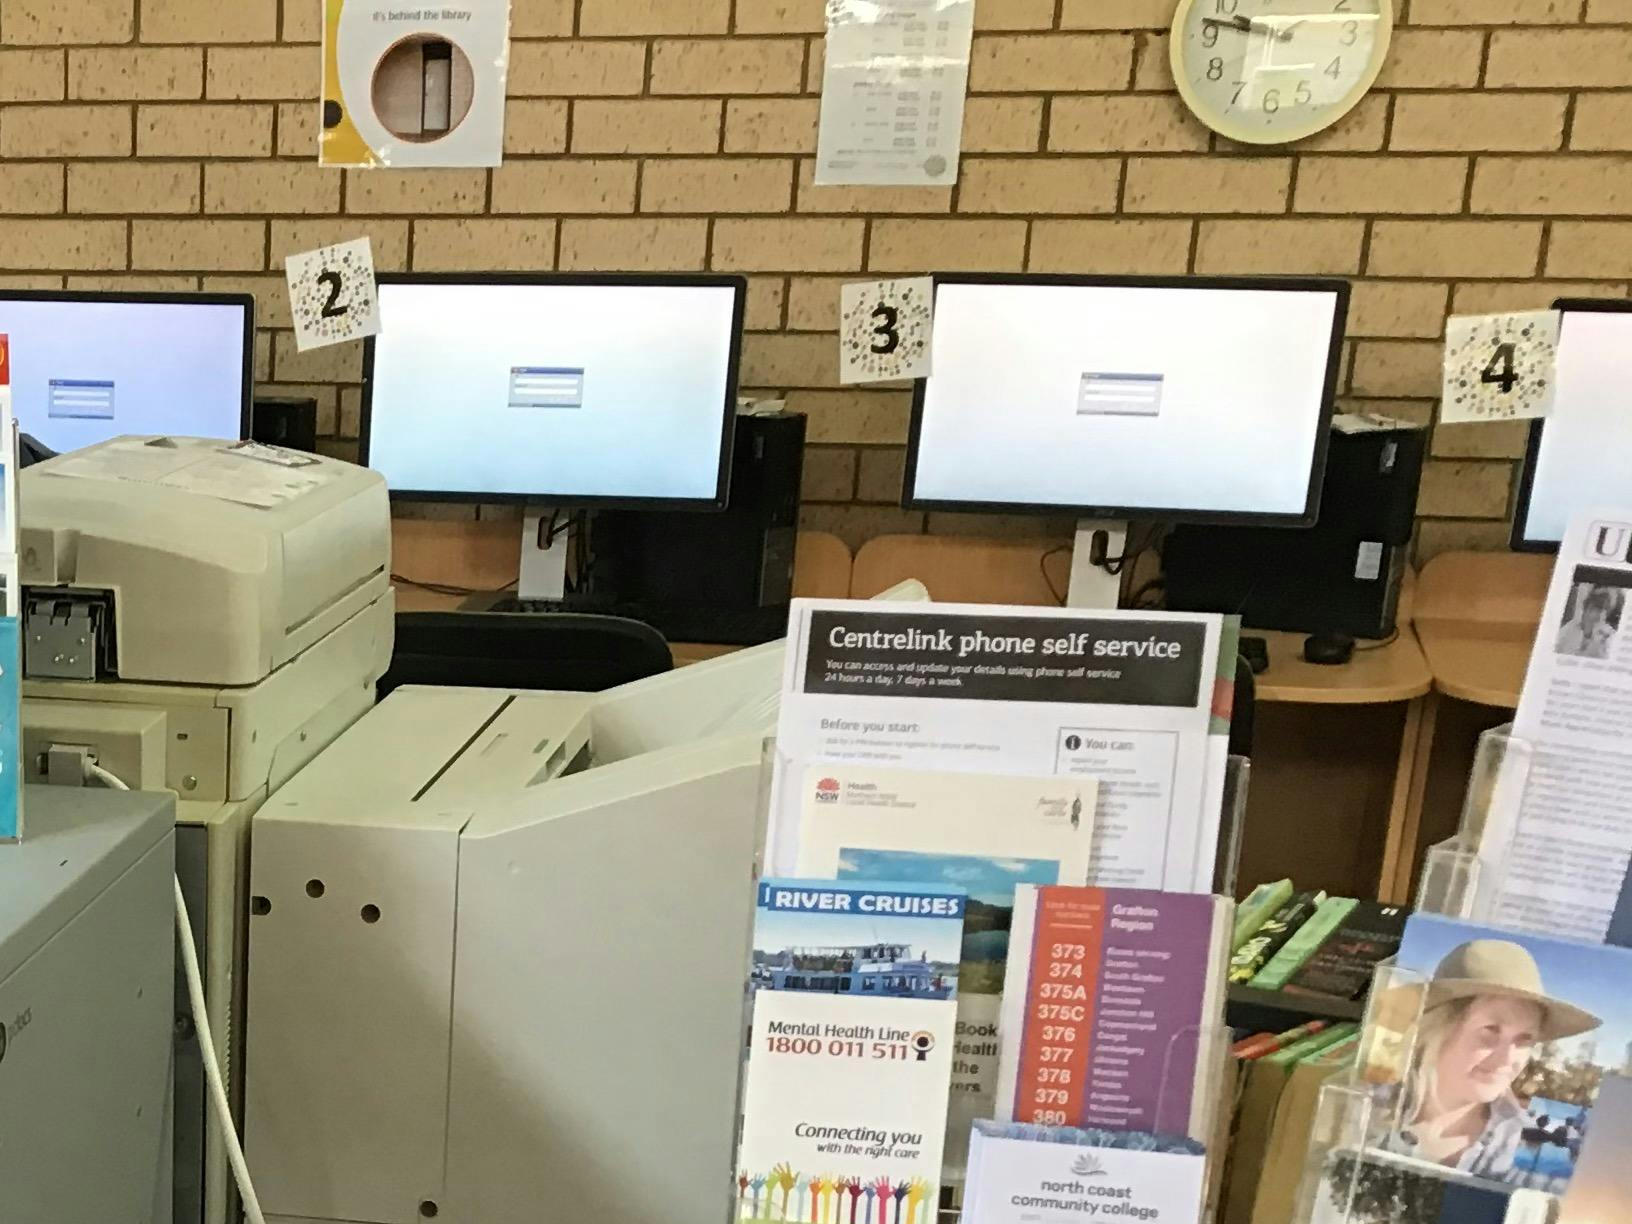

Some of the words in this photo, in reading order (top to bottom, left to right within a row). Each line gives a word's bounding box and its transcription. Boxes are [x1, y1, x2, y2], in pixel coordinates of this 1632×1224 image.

[388, 10, 420, 20] behind
[424, 10, 439, 20] the
[442, 10, 472, 20] library
[1203, 24, 1218, 48] 9
[1340, 20, 1358, 46] 3
[1206, 57, 1223, 80] 8
[1324, 56, 1341, 79] 4
[1232, 81, 1247, 104] 7
[1294, 80, 1311, 104] 5
[1262, 89, 1279, 114] 6
[316, 271, 349, 318] 2
[872, 305, 899, 354] 3
[1481, 343, 1518, 394] 4
[829, 626, 952, 652] Centrelink
[959, 631, 1034, 657] phone
[1042, 633, 1088, 656] self
[1094, 637, 1181, 659] service
[826, 659, 843, 670] You
[845, 662, 862, 671] can
[864, 663, 894, 672] access
[897, 662, 915, 672] and
[916, 664, 949, 675] update
[951, 666, 972, 676] your
[974, 664, 1006, 675] details
[1008, 667, 1033, 678] using
[1036, 667, 1064, 678] phone
[1067, 668, 1085, 678] self
[1087, 669, 1121, 679] service
[824, 673, 837, 682] 24
[839, 673, 865, 683] hours
[904, 675, 926, 687] days
[821, 718, 860, 732] Before
[862, 722, 885, 734] you
[1085, 737, 1111, 749] You
[775, 890, 851, 910] RIVER
[859, 894, 959, 916] CRUISES
[1112, 904, 1159, 917] Grafton
[1111, 918, 1154, 931] Region
[1052, 943, 1086, 960] 373
[1049, 962, 1082, 978] 374
[1040, 983, 1087, 1000] 375A
[1038, 1004, 1085, 1021] 375C
[768, 1021, 820, 1037] Mental
[825, 1024, 874, 1040] Health
[878, 1027, 910, 1041] Line
[956, 1021, 997, 1037] Book
[1042, 1026, 1076, 1042] 376
[766, 1037, 822, 1055] 1800
[828, 1040, 864, 1058] 011
[872, 1042, 908, 1060] 511
[1040, 1047, 1074, 1062] 377
[1037, 1068, 1071, 1084] 378
[1035, 1088, 1069, 1104] 379
[1032, 1109, 1066, 1125] 380
[795, 1123, 886, 1145] Connecting
[891, 1131, 922, 1149] you
[817, 1143, 841, 1153] with
[845, 1144, 862, 1155] the
[865, 1146, 892, 1159] right
[894, 1149, 920, 1159] care
[1041, 1181, 1084, 1194] north
[1088, 1185, 1132, 1199] coast
[1011, 1195, 1099, 1215] community
[1102, 1202, 1159, 1220] college
